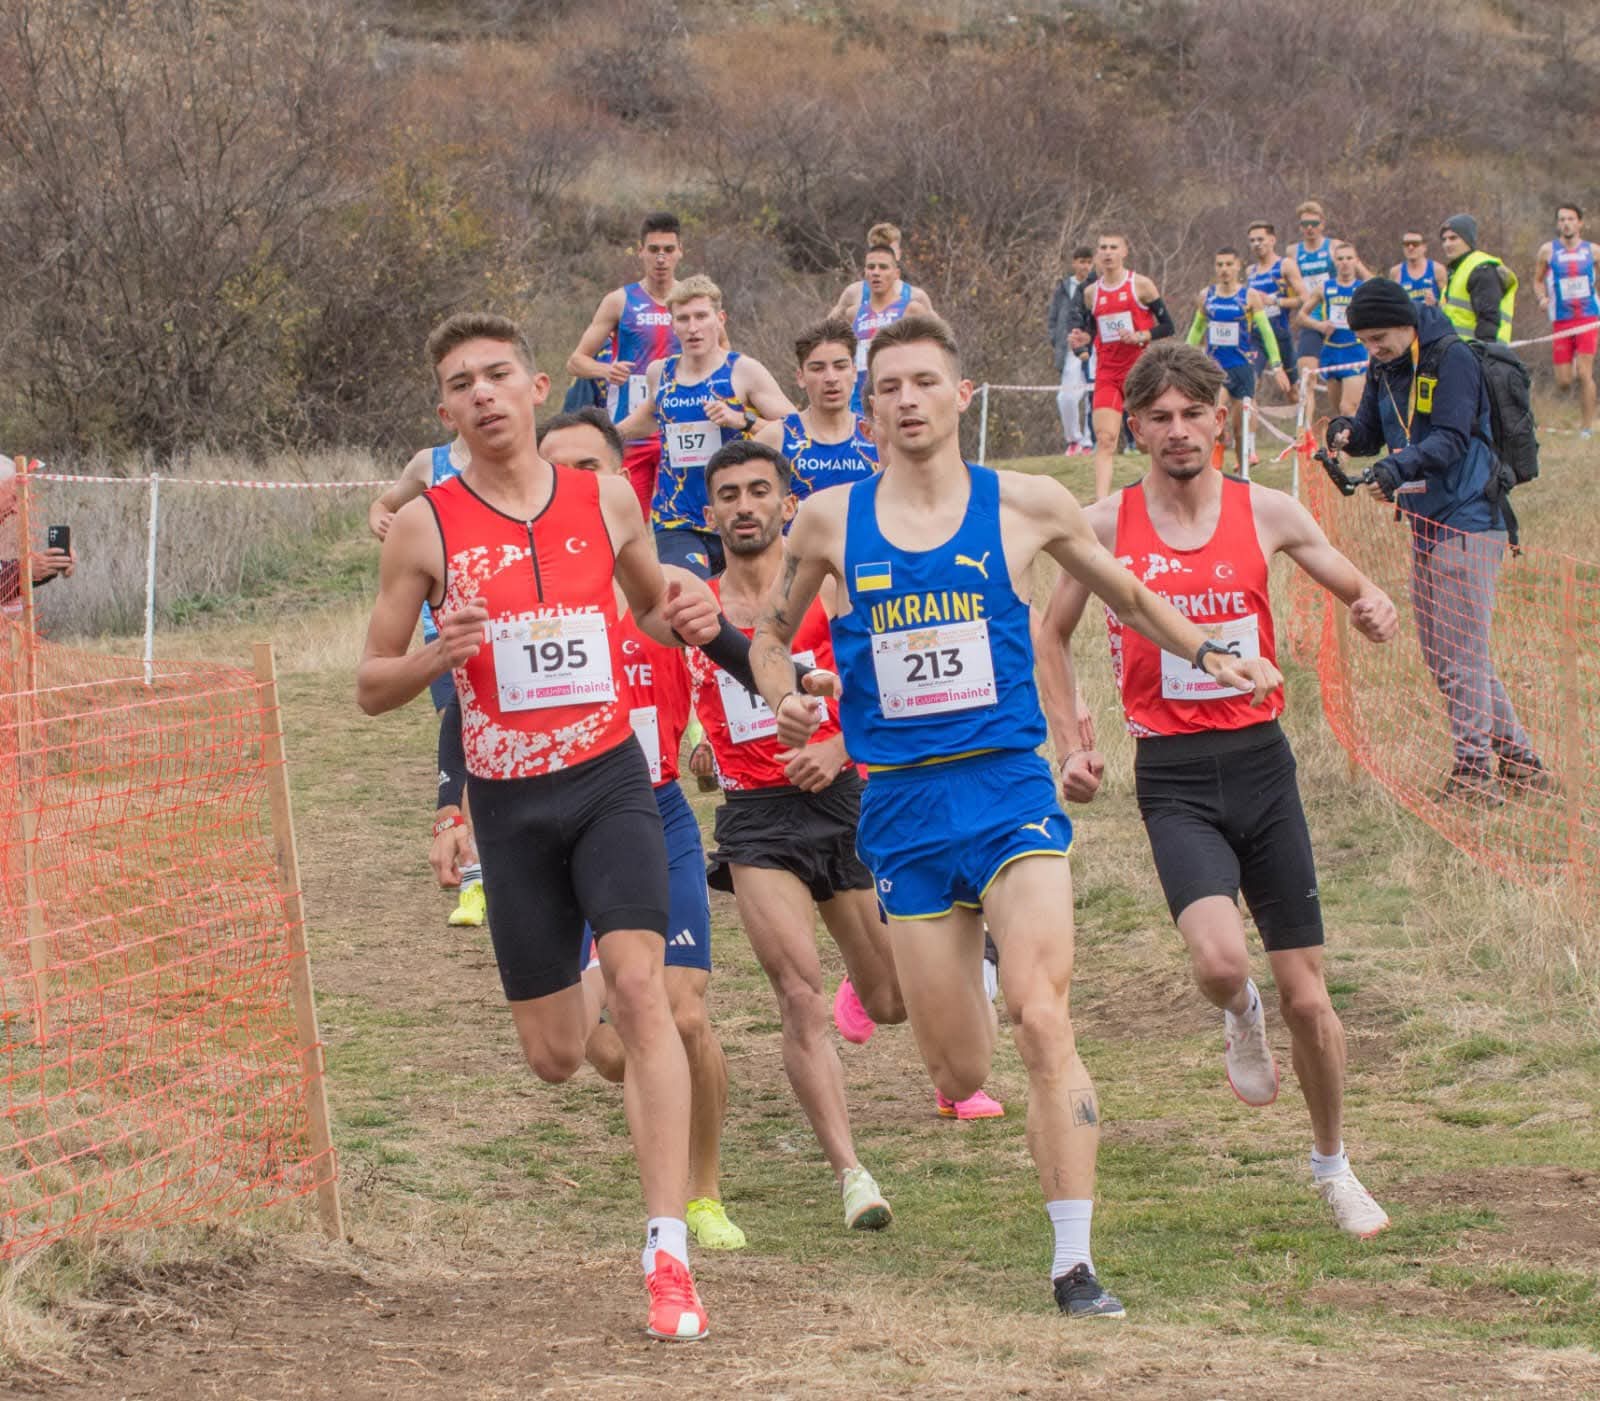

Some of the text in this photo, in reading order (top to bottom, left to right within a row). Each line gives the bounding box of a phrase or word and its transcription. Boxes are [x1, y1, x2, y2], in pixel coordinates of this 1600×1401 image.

[635, 312, 673, 326] SERB
[677, 433, 706, 450] 157
[797, 457, 866, 471] ROMANIA
[871, 591, 985, 634] UKRAINE
[1158, 587, 1248, 617] RKİYE
[523, 639, 588, 673] 195
[903, 647, 964, 683] 213
